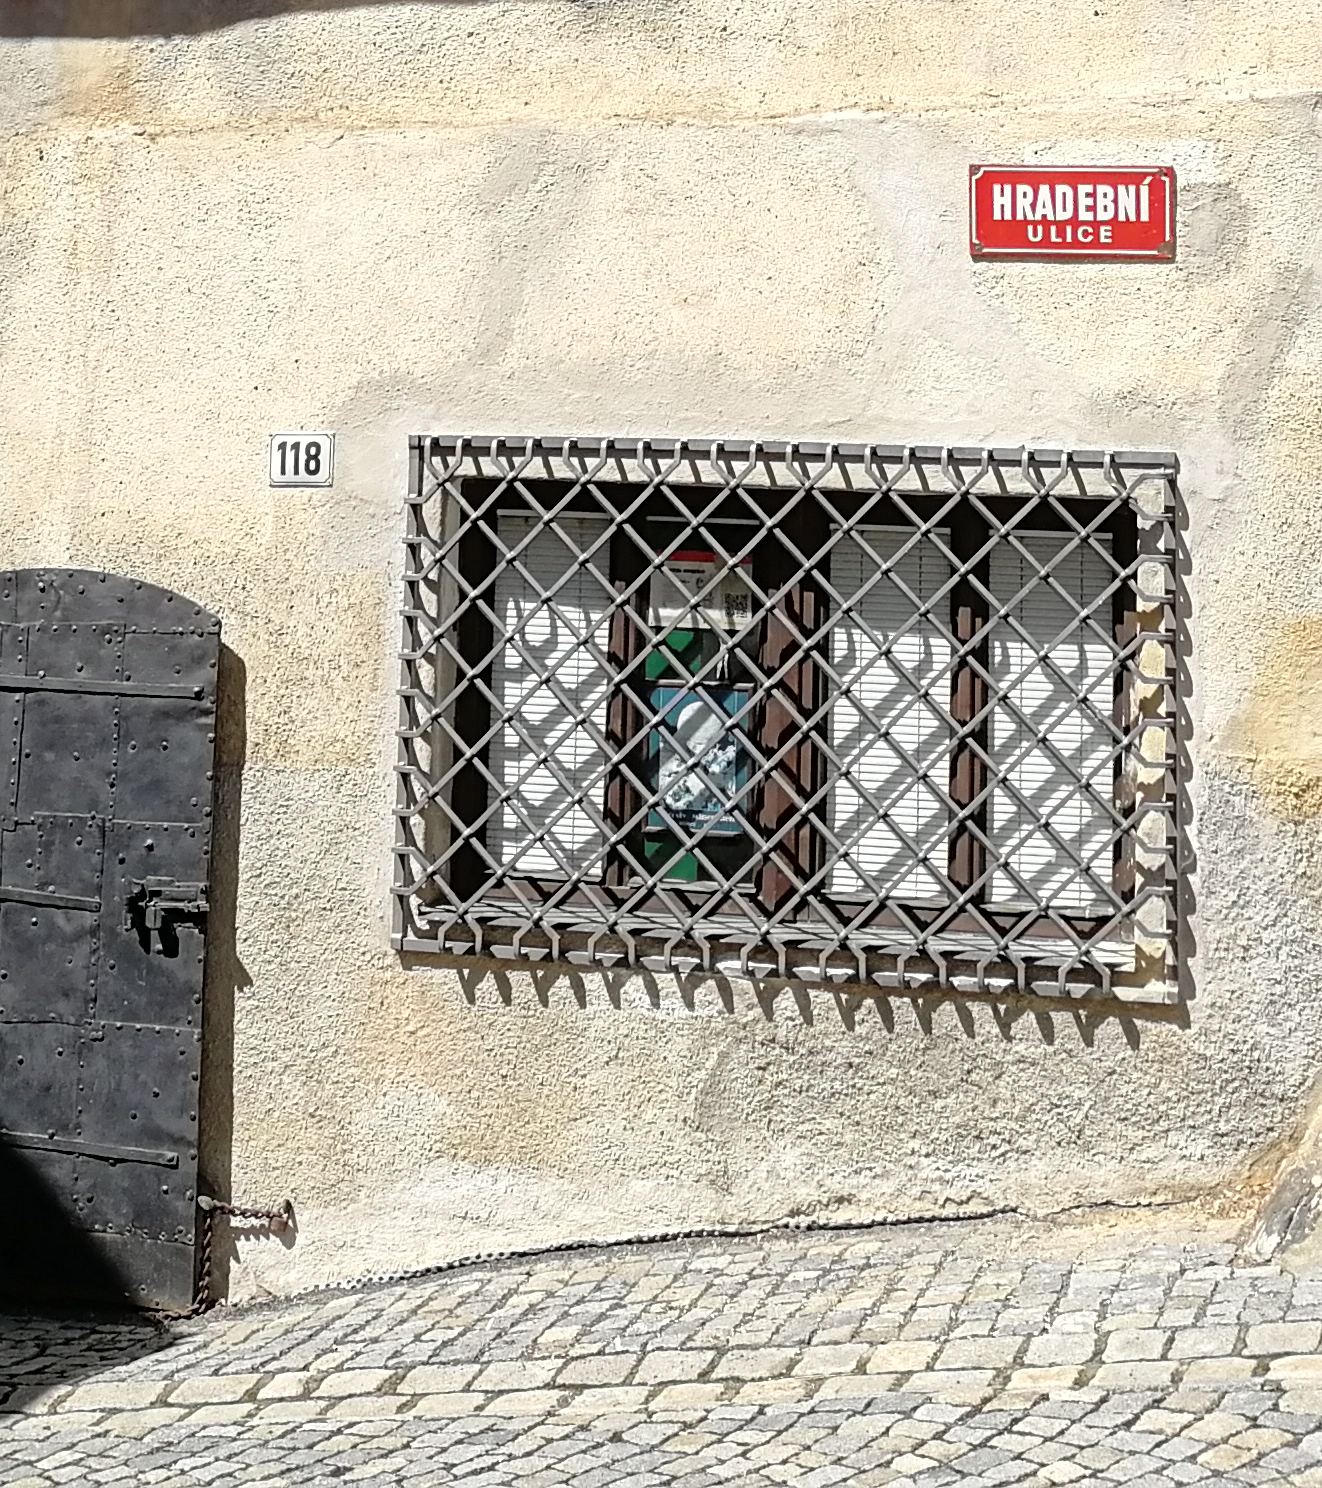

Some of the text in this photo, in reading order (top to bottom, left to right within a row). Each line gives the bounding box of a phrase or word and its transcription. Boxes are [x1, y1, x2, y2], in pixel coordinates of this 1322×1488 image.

[992, 176, 1152, 222] HRADEBNÍ
[1027, 224, 1113, 243] ULICE
[277, 440, 322, 476] 118
